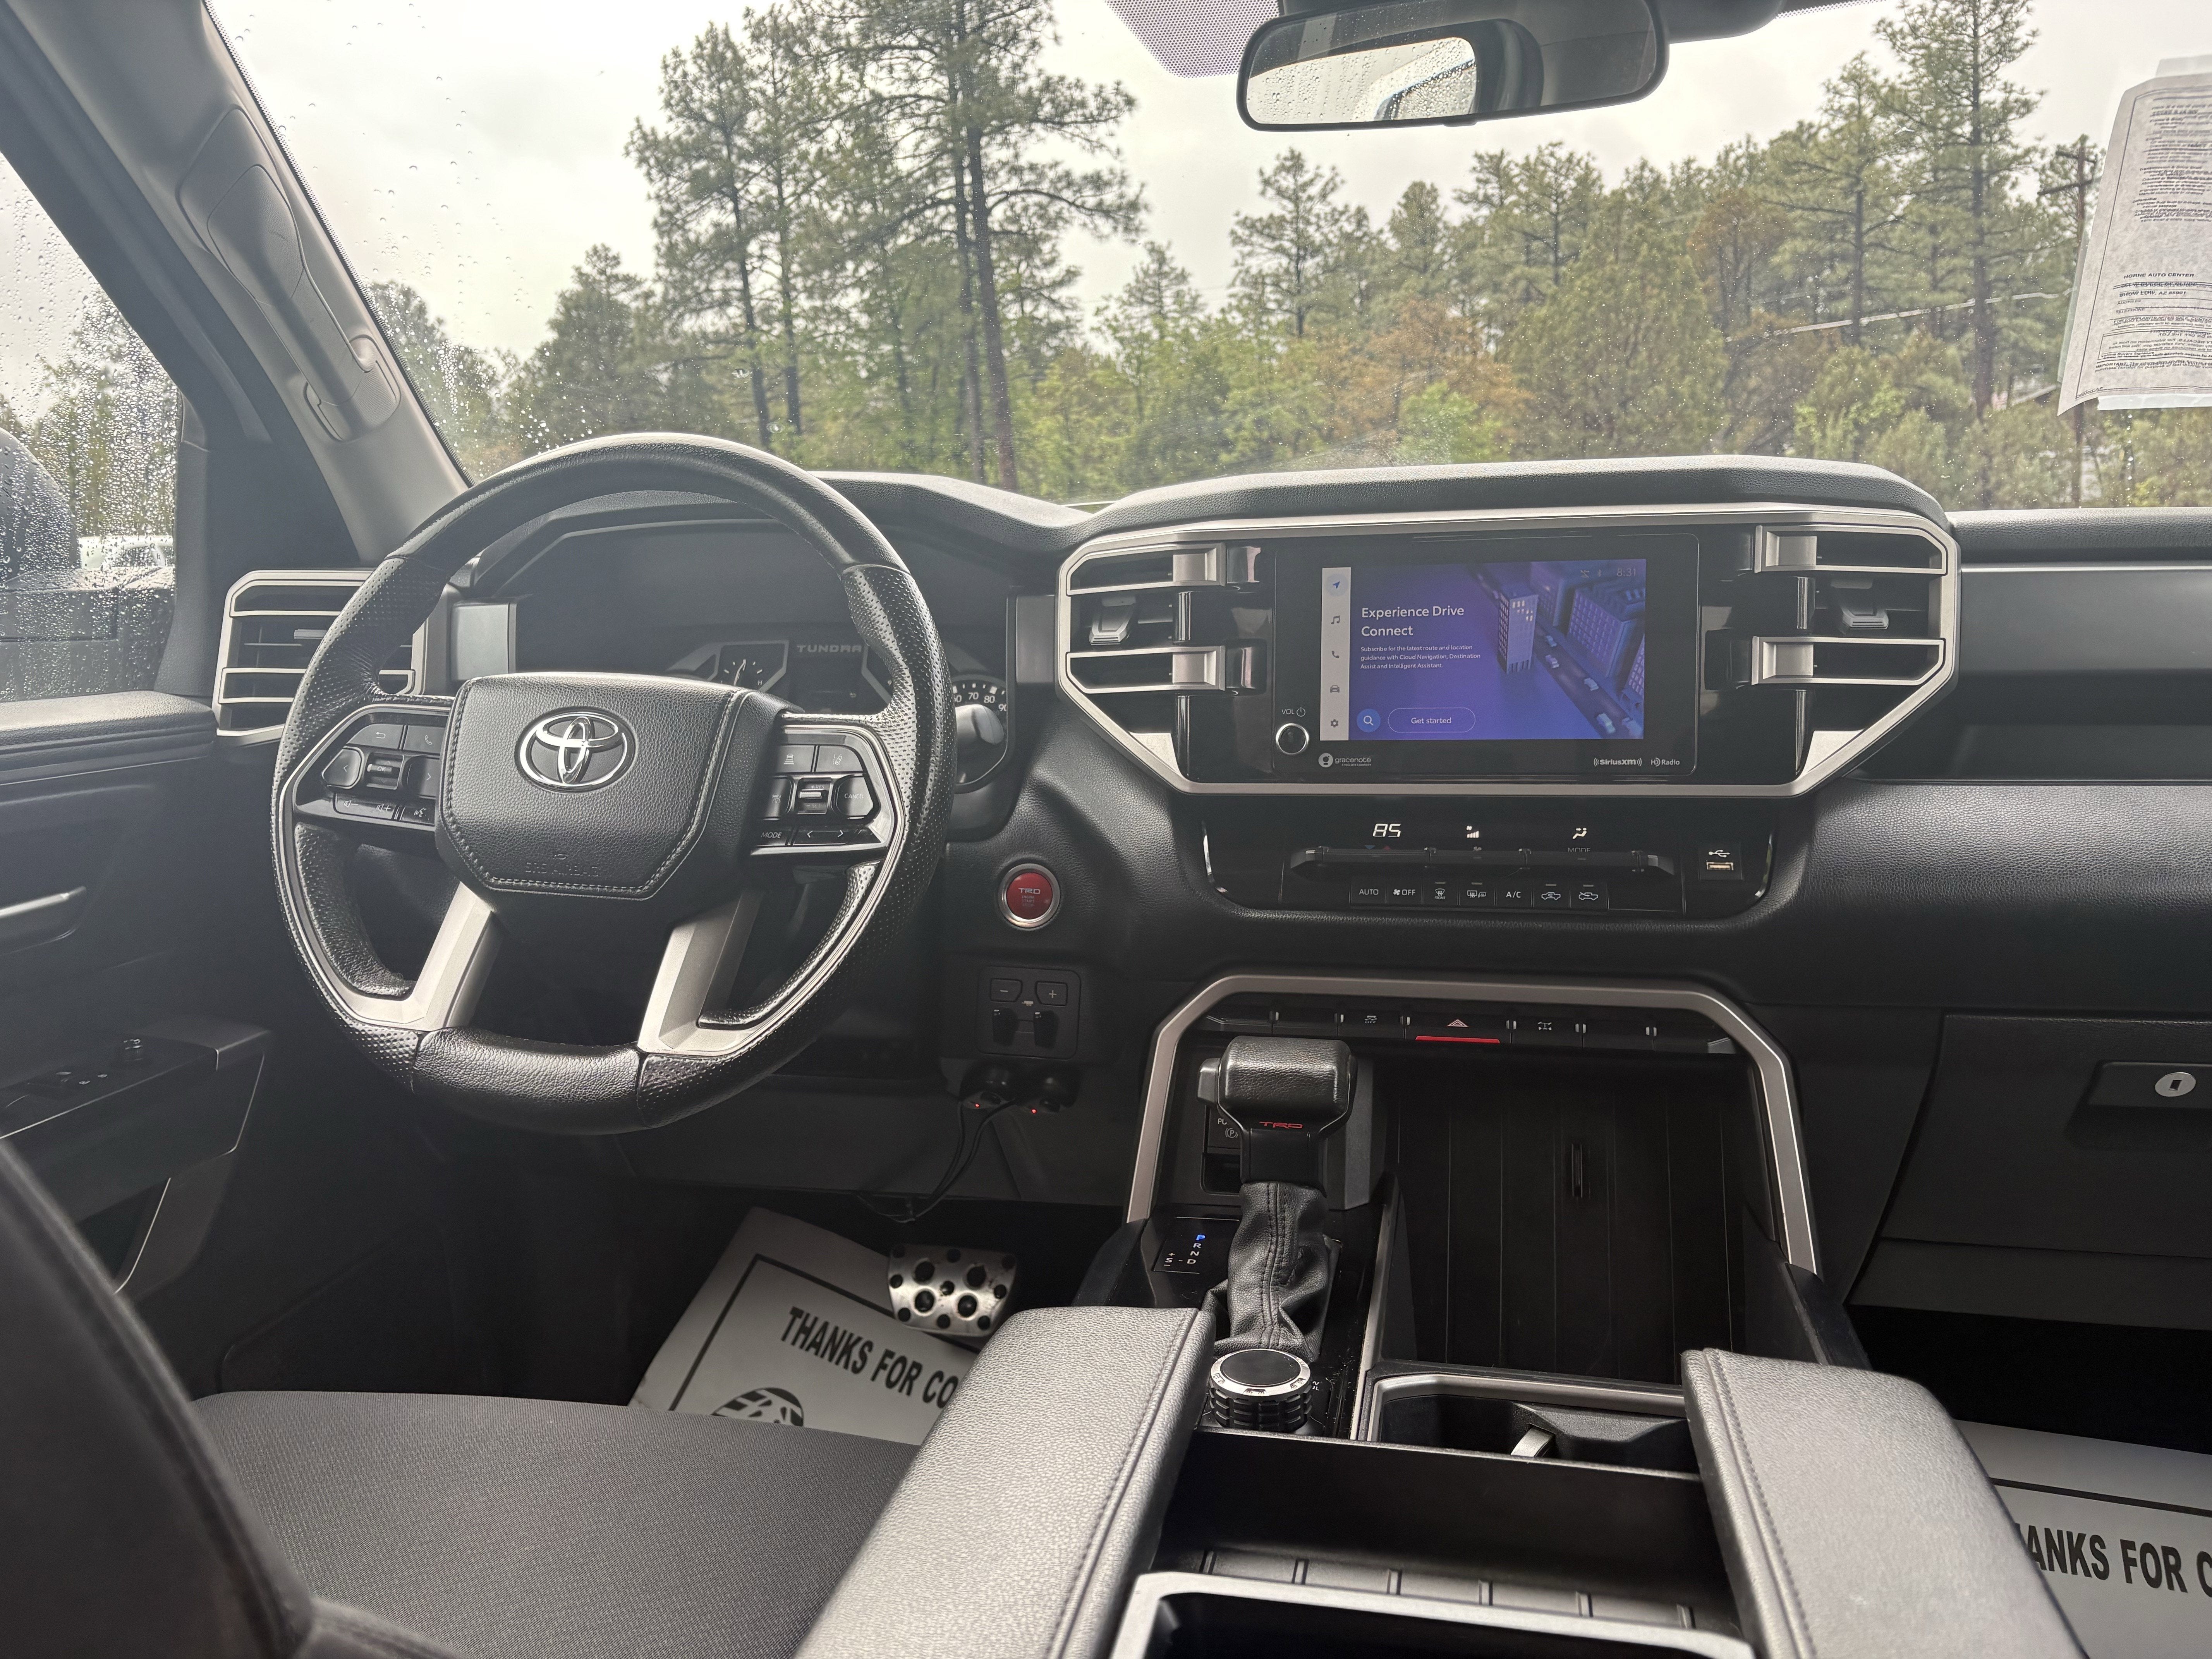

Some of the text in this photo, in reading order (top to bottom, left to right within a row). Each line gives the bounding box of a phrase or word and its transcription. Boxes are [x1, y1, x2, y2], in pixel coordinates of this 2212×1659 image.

[1617, 568, 1637, 577] 8:31
[1362, 606, 1464, 620] Experience Drive
[1361, 626, 1413, 636] Connect
[797, 644, 862, 653] TUNDRA
[968, 692, 979, 700] 70
[984, 696, 995, 704] 80
[1372, 823, 1401, 837] 85
[780, 1306, 959, 1409] THANKS FOR CO
[2014, 1523, 2109, 1580] ANKS
[2119, 1539, 2188, 1593] FOR
